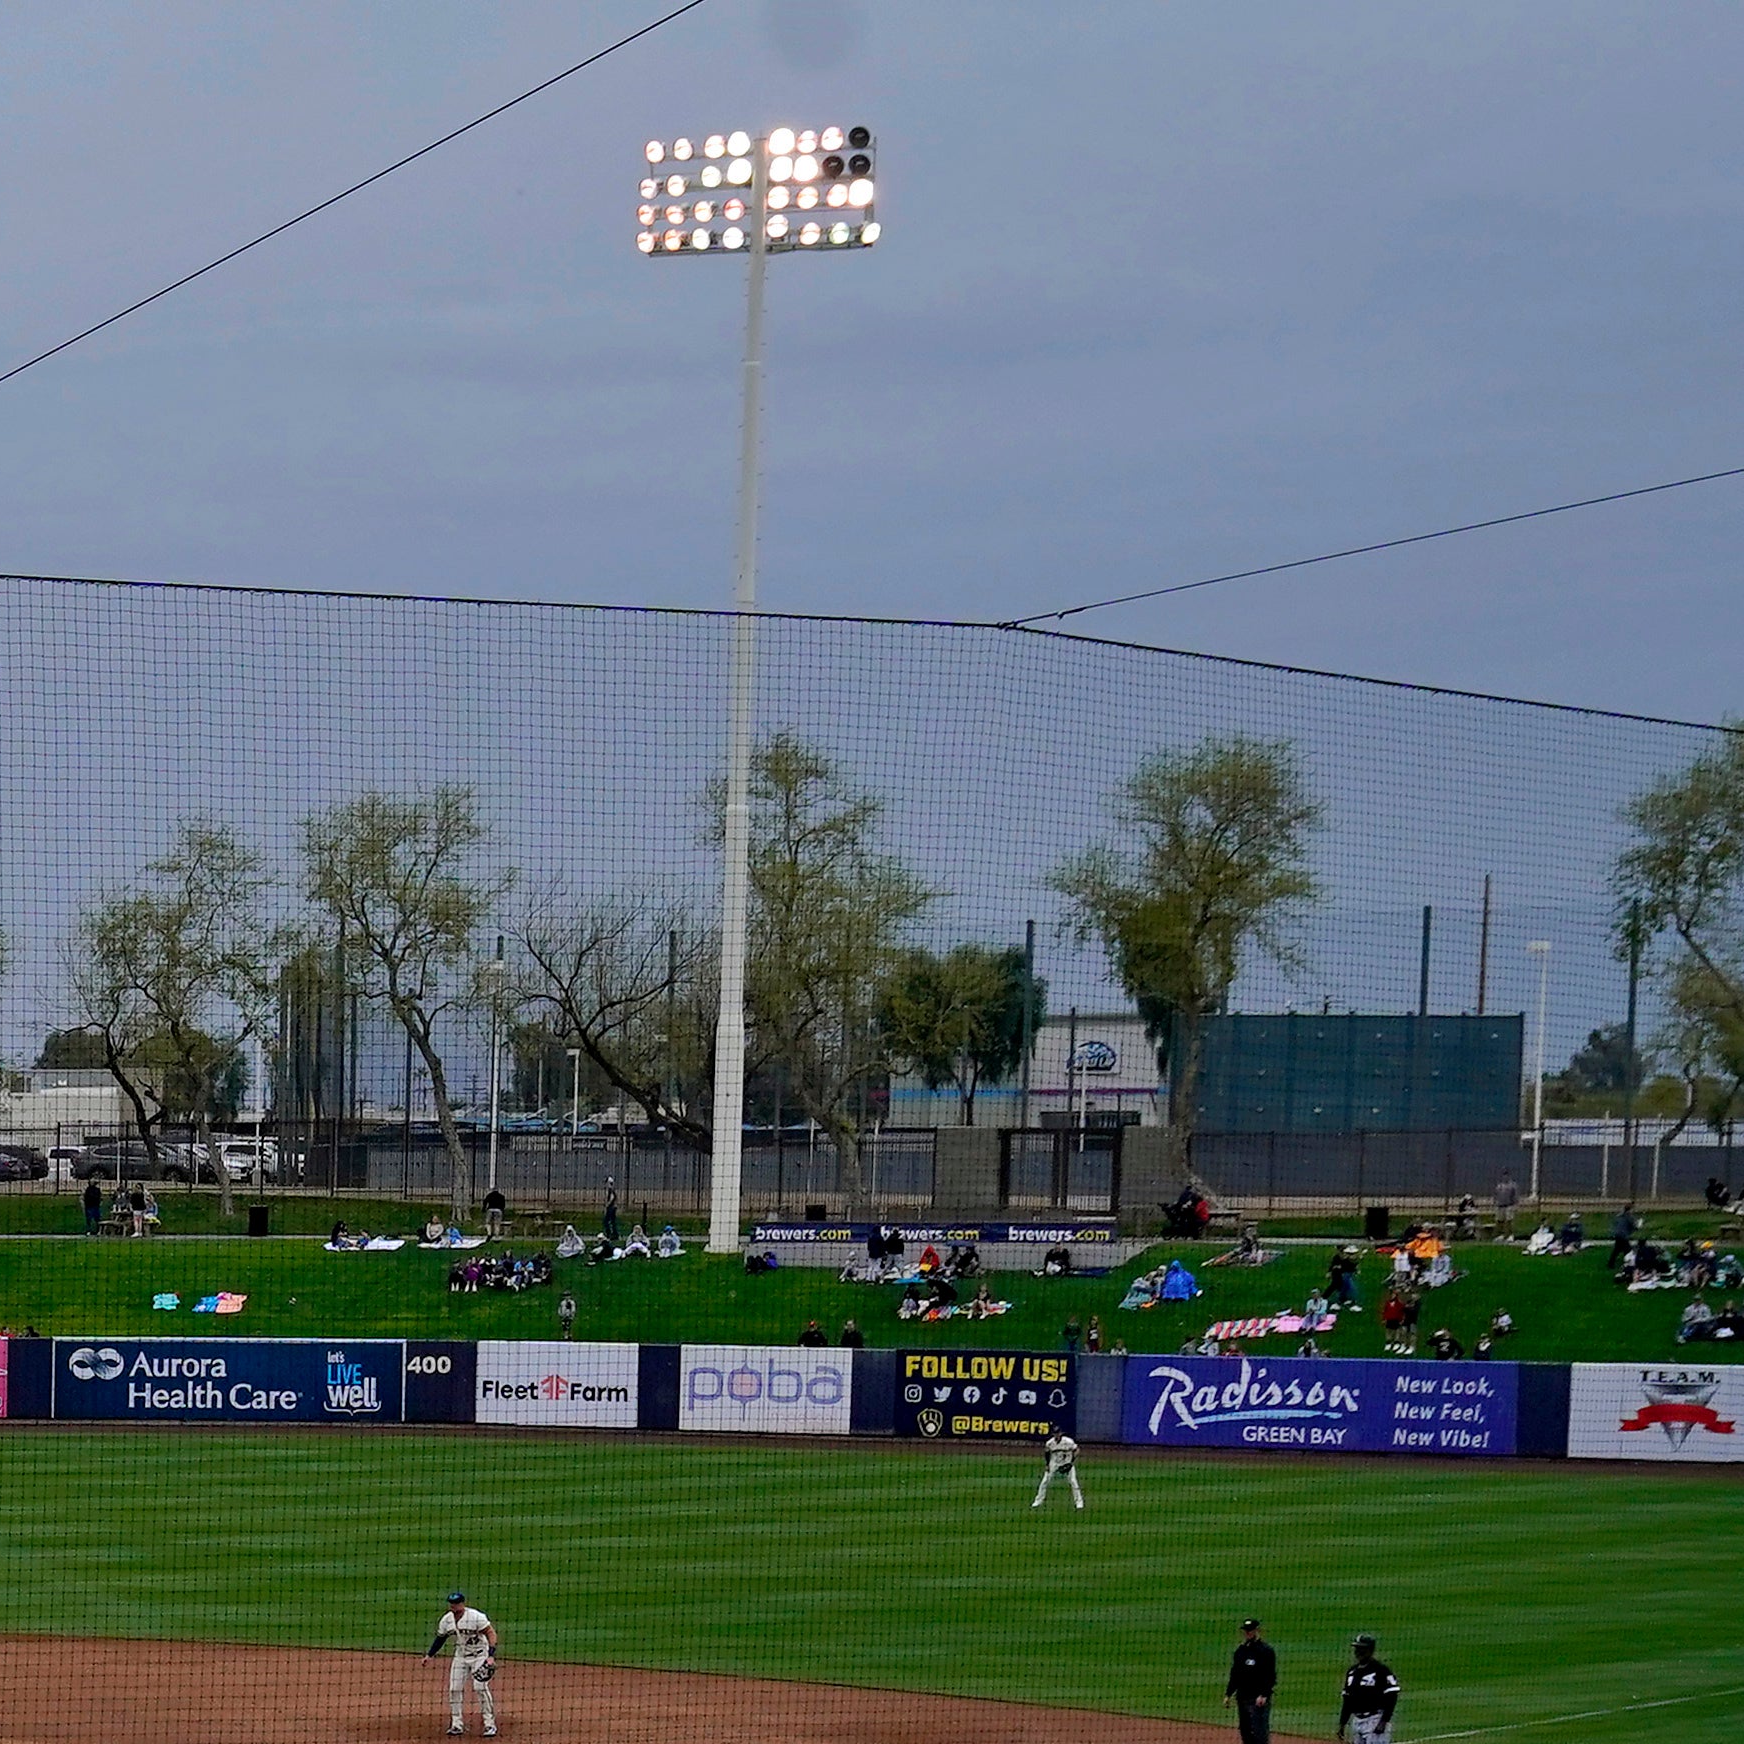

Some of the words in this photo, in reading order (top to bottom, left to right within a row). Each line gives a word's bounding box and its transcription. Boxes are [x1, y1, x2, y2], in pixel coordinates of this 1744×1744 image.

[755, 1227, 851, 1241] brewers.com
[1008, 1226, 1110, 1241] brewers.com
[128, 1351, 227, 1378] Aurora
[327, 1351, 345, 1364] let's
[407, 1356, 451, 1374] 400
[327, 1364, 362, 1385] LIVE
[905, 1356, 1016, 1380] FOLLOW
[1022, 1358, 1068, 1382] US!
[1640, 1370, 1721, 1384] T.E.A.M.
[128, 1381, 223, 1409] Health
[230, 1383, 298, 1410] Care
[328, 1377, 378, 1409] well
[482, 1380, 539, 1401] Fleet
[570, 1382, 628, 1402] Farm
[1148, 1358, 1359, 1436] Radisson
[1395, 1375, 1438, 1394] New
[1441, 1376, 1496, 1398] Look,
[1394, 1402, 1435, 1420] New
[1440, 1403, 1486, 1424] Feel,
[951, 1415, 1050, 1435] @Brewers
[1242, 1425, 1305, 1443] GREEN
[1309, 1427, 1347, 1445] BAY
[1392, 1428, 1434, 1446] New
[1439, 1429, 1490, 1448] Vibe!
